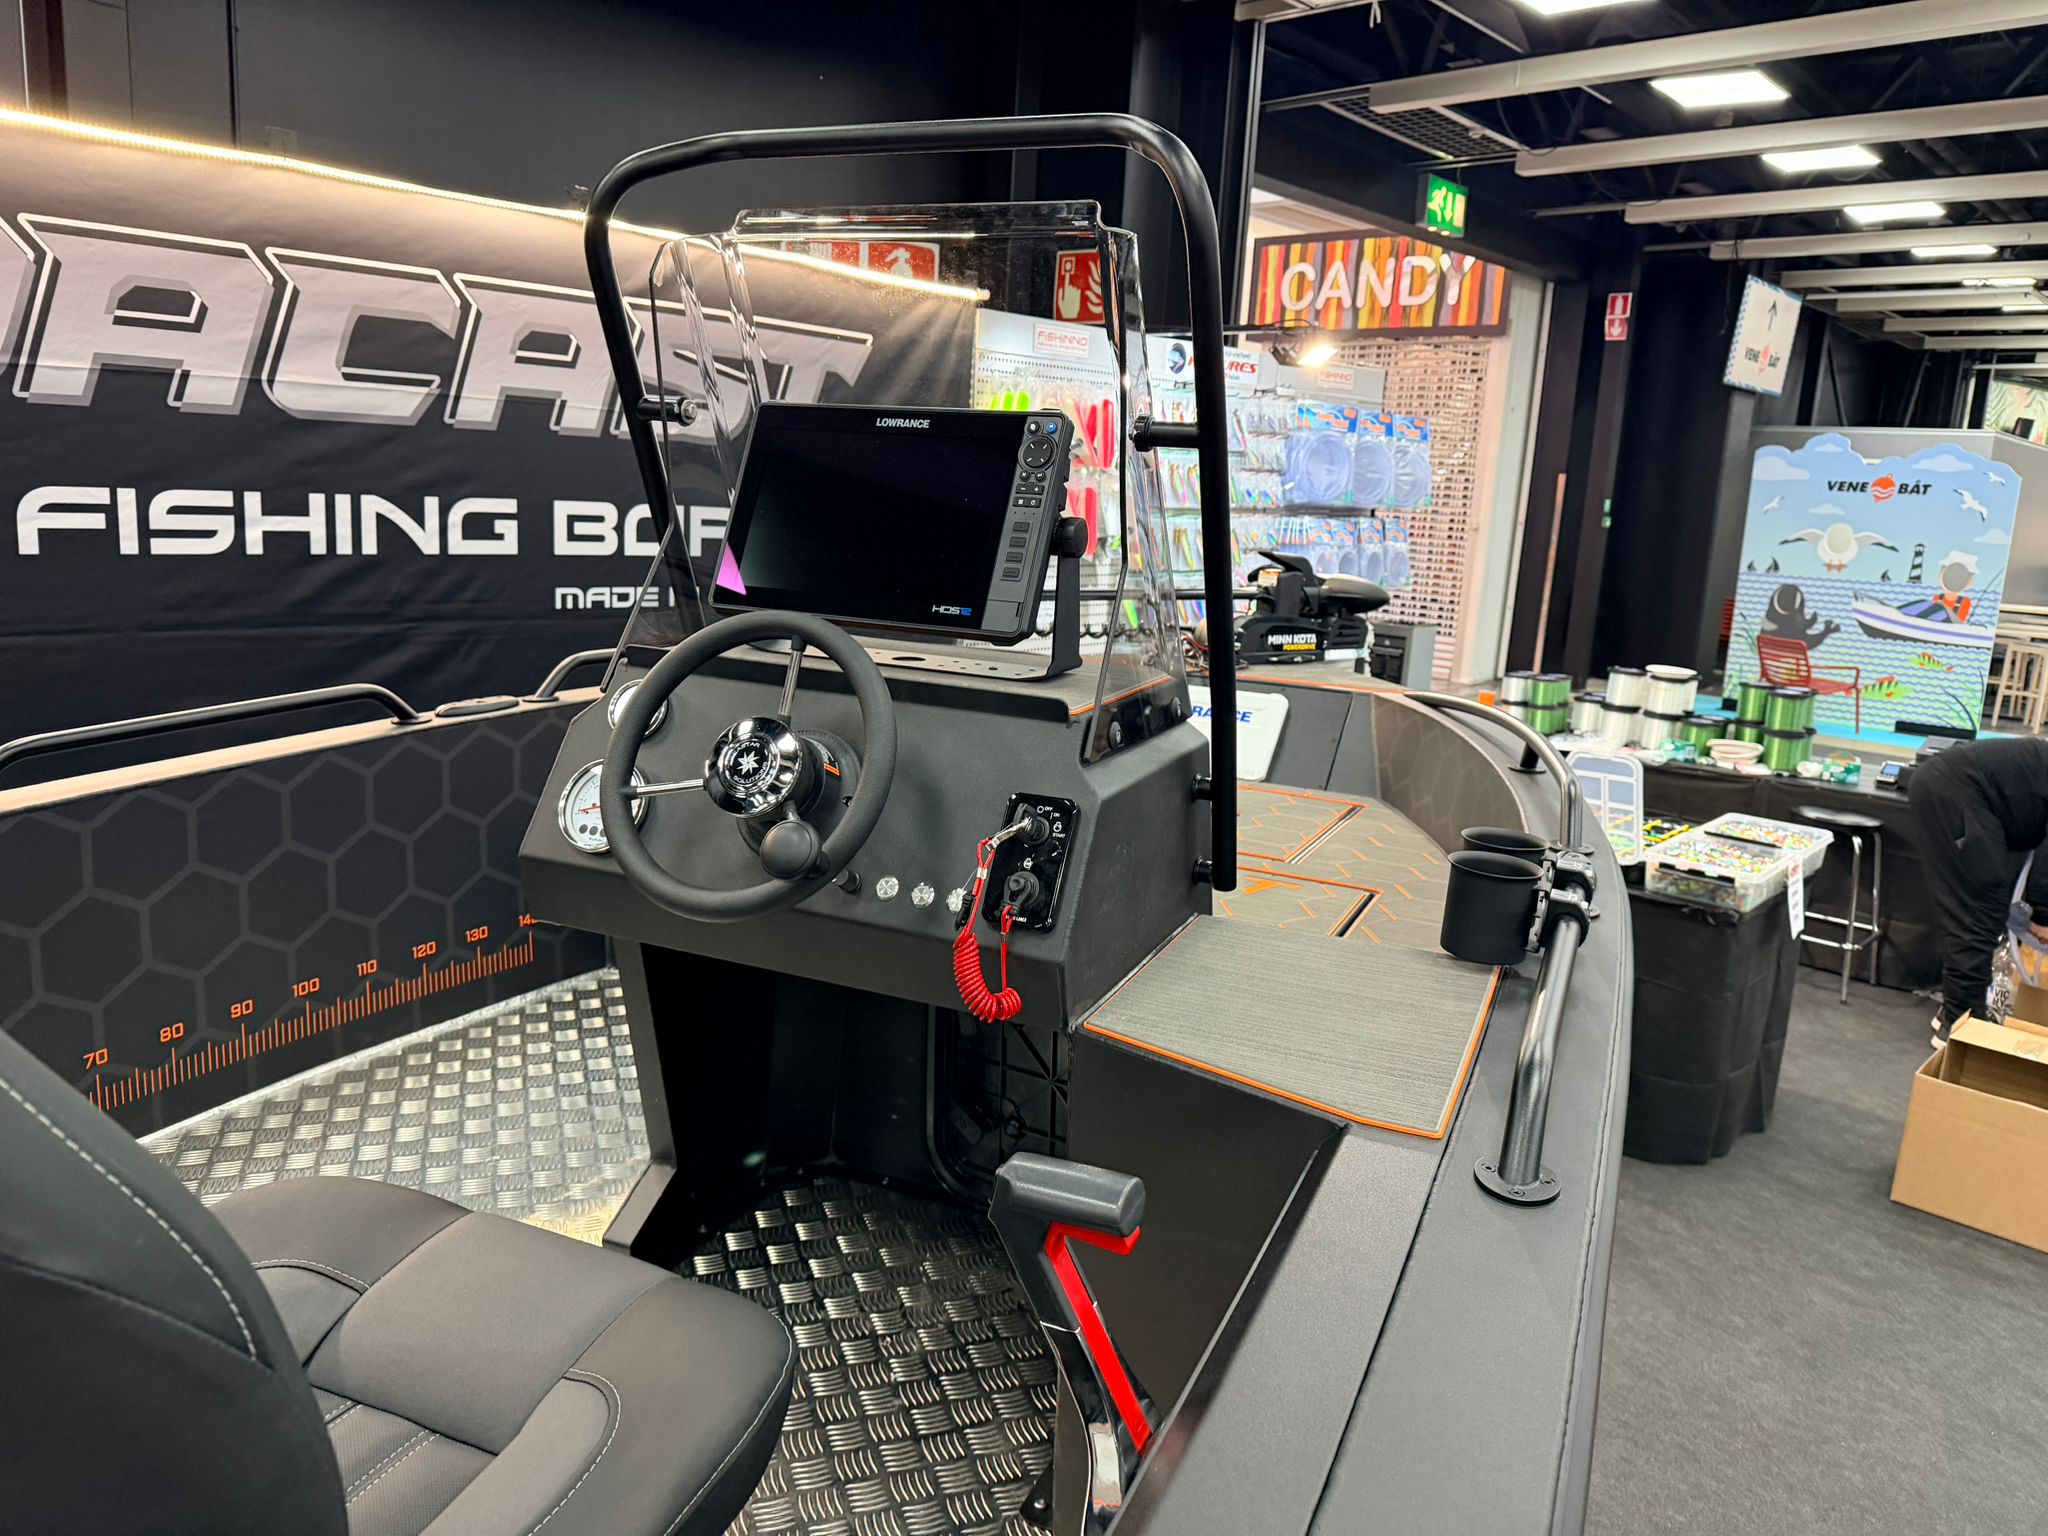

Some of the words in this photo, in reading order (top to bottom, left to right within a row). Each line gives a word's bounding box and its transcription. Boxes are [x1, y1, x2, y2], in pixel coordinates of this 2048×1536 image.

[1281, 253, 1476, 311] CANDY
[0, 212, 873, 448] ACAST
[876, 417, 931, 429] LOWRANCE
[1827, 480, 1869, 493] VENE
[1898, 479, 1932, 495] BÅT
[16, 485, 519, 556] FISHING
[555, 586, 660, 610] MADE
[1268, 634, 1292, 645] MINN
[1293, 633, 1317, 644] KOTA
[83, 1048, 108, 1070] 70
[160, 1023, 184, 1042] 80
[230, 1000, 254, 1019] 90
[292, 977, 320, 997] 100
[356, 959, 378, 977] 110
[412, 941, 437, 959] 120
[465, 926, 489, 943] 130
[518, 913, 538, 927] 14
